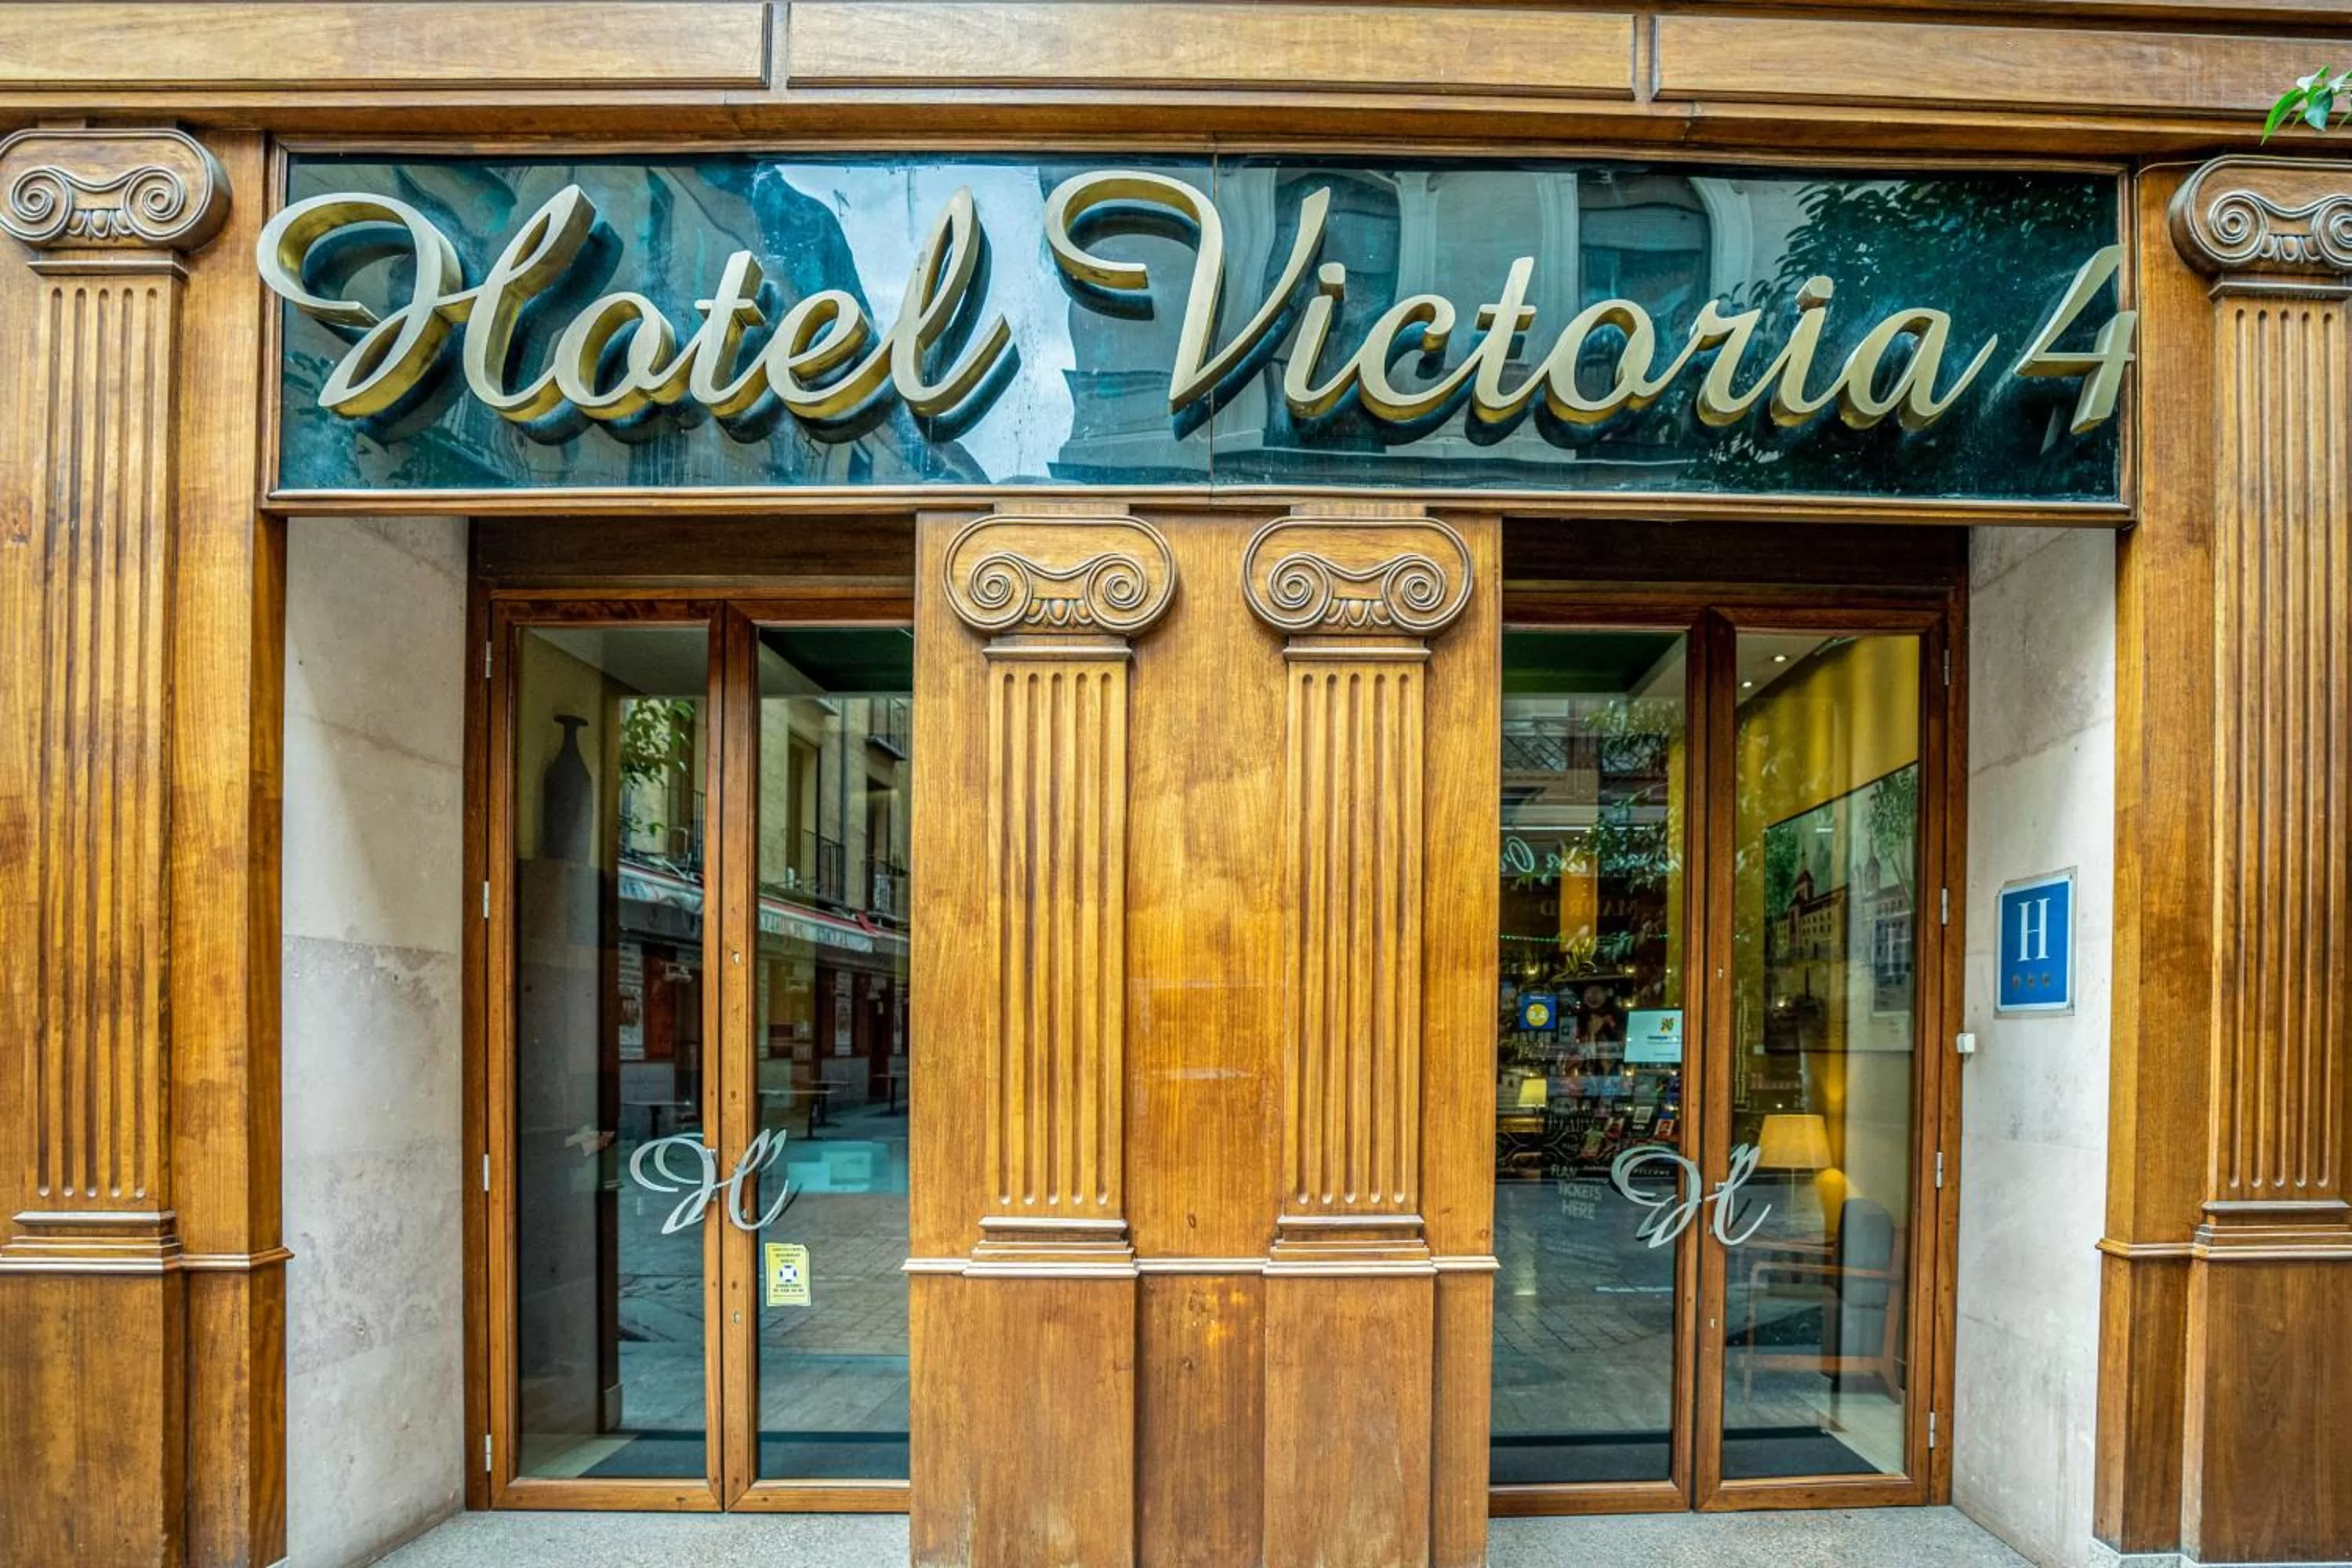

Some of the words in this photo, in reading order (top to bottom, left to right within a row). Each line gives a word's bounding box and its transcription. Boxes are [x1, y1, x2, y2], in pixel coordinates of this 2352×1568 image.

[257, 183, 1011, 422] Hotel
[1044, 169, 1998, 430] Victoria
[2014, 244, 2136, 433] 4
[2017, 897, 2051, 963] H
[1561, 1199, 1596, 1221] HERE
